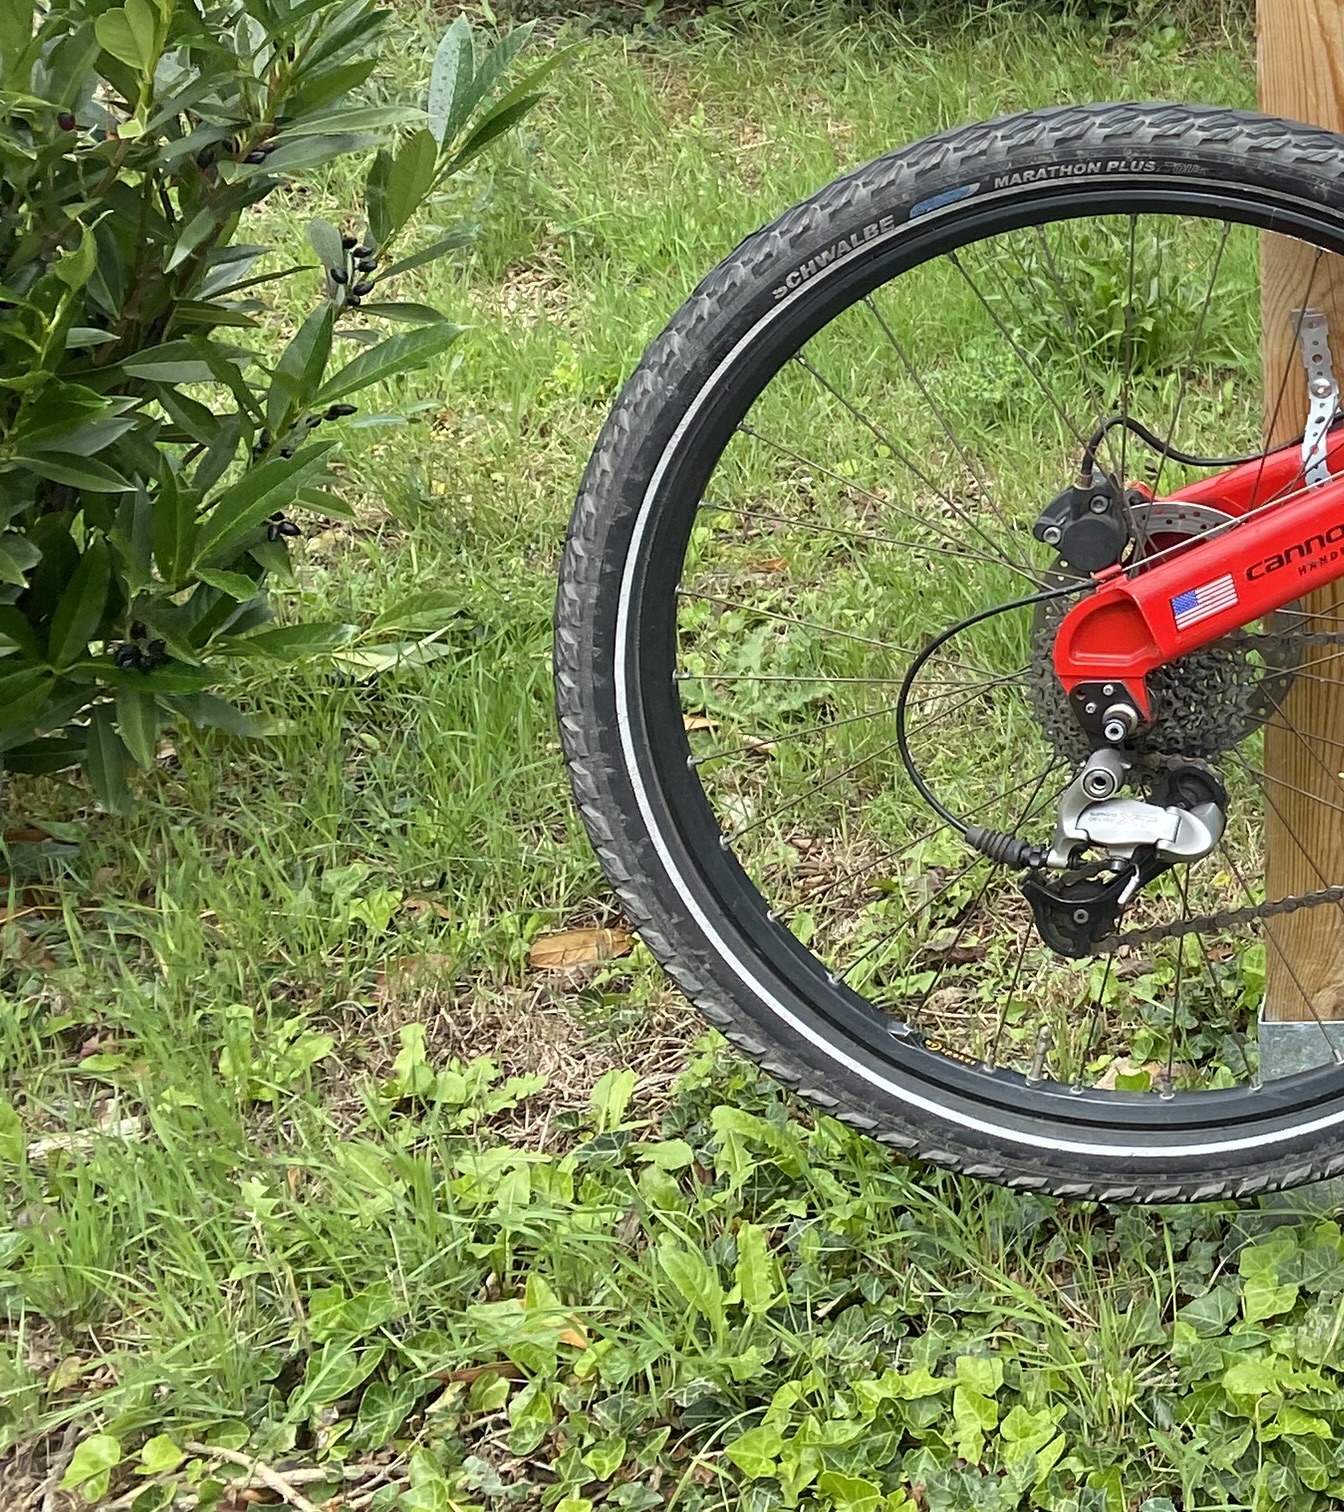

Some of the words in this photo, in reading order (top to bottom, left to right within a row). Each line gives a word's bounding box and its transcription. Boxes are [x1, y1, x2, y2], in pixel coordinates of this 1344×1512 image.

[994, 161, 1101, 189] MARATHON
[1106, 160, 1156, 174] PLUS
[771, 214, 896, 300] SCHWALBE
